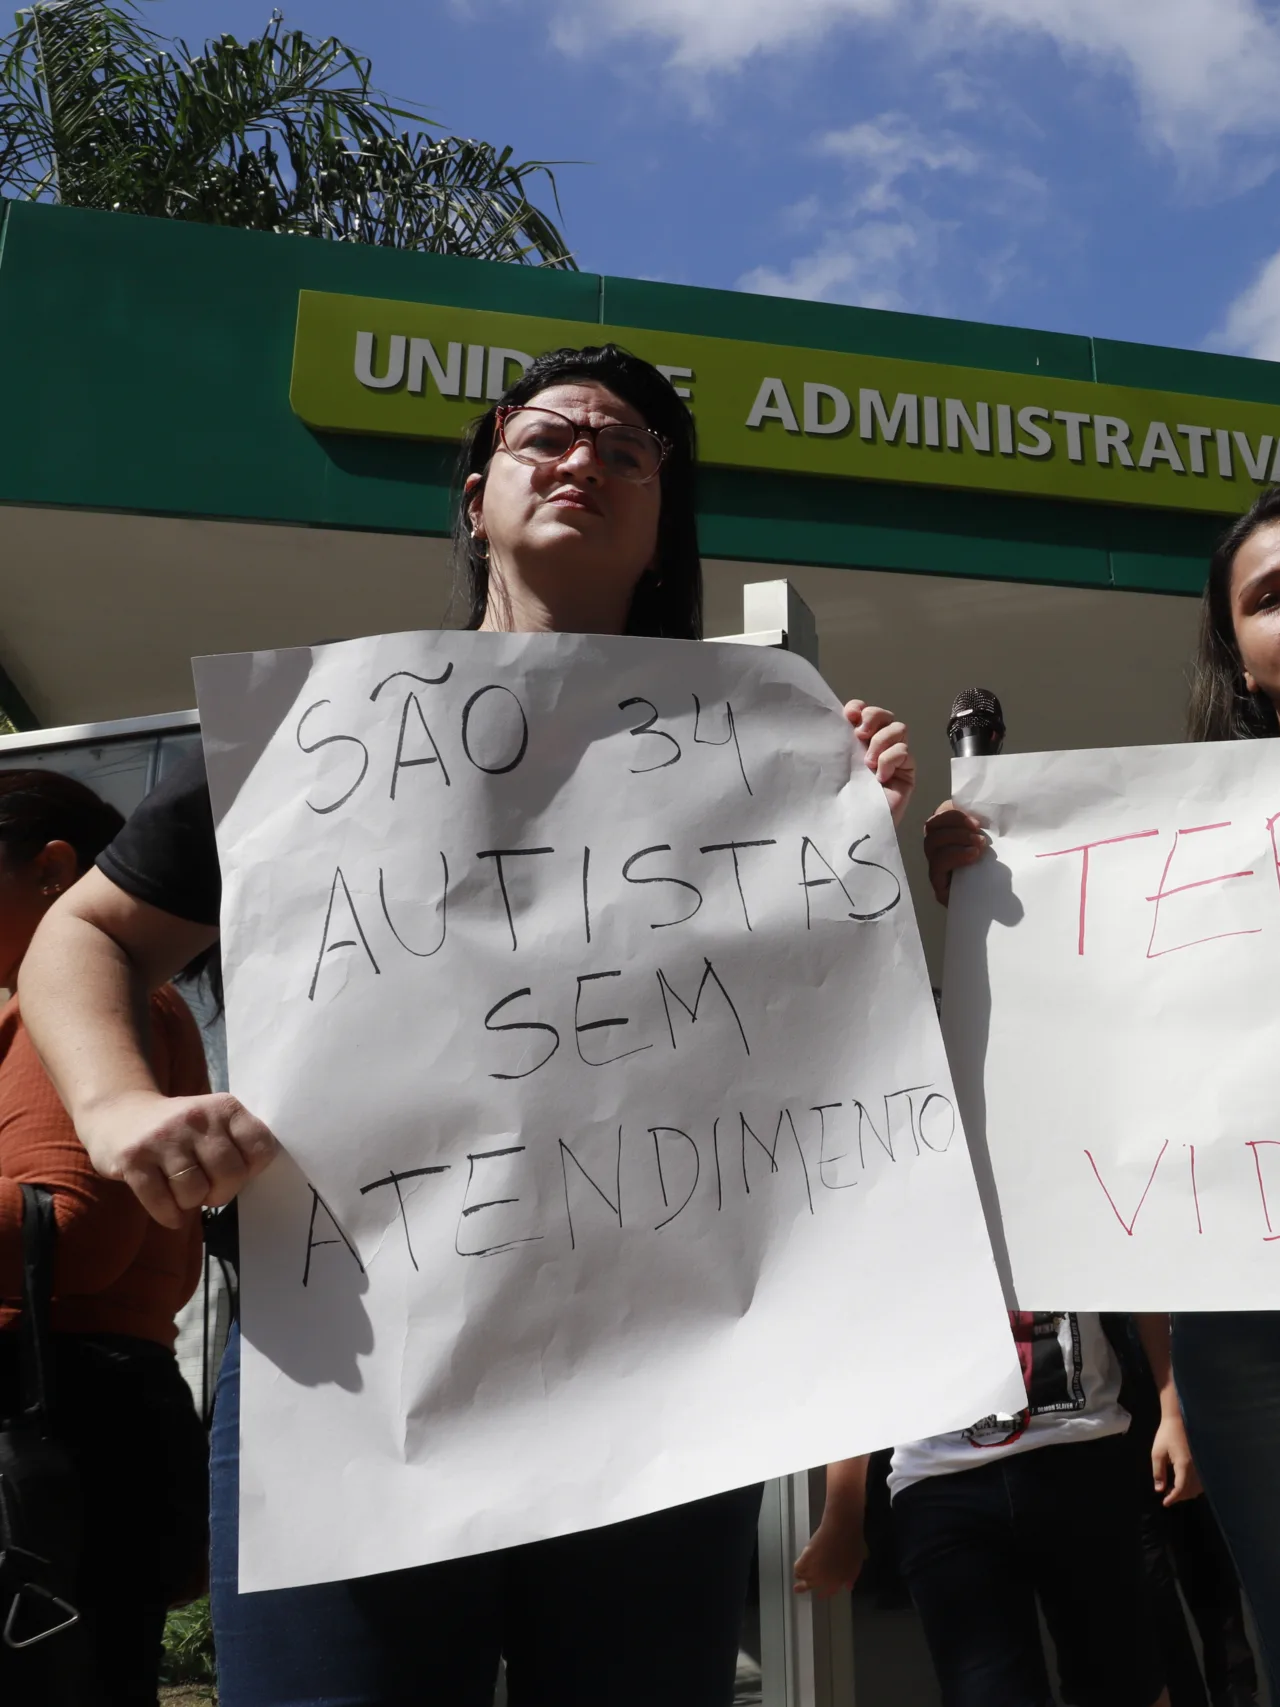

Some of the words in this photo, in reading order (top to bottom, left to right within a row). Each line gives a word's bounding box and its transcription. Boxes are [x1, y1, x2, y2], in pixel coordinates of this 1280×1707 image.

[353, 330, 693, 416] UNIDE
[296, 662, 530, 814] SÃO
[618, 692, 754, 796] 34
[308, 835, 902, 1000] AUTISTAS
[484, 957, 751, 1081] SEM
[303, 1083, 956, 1287] ATENDIMENTO
